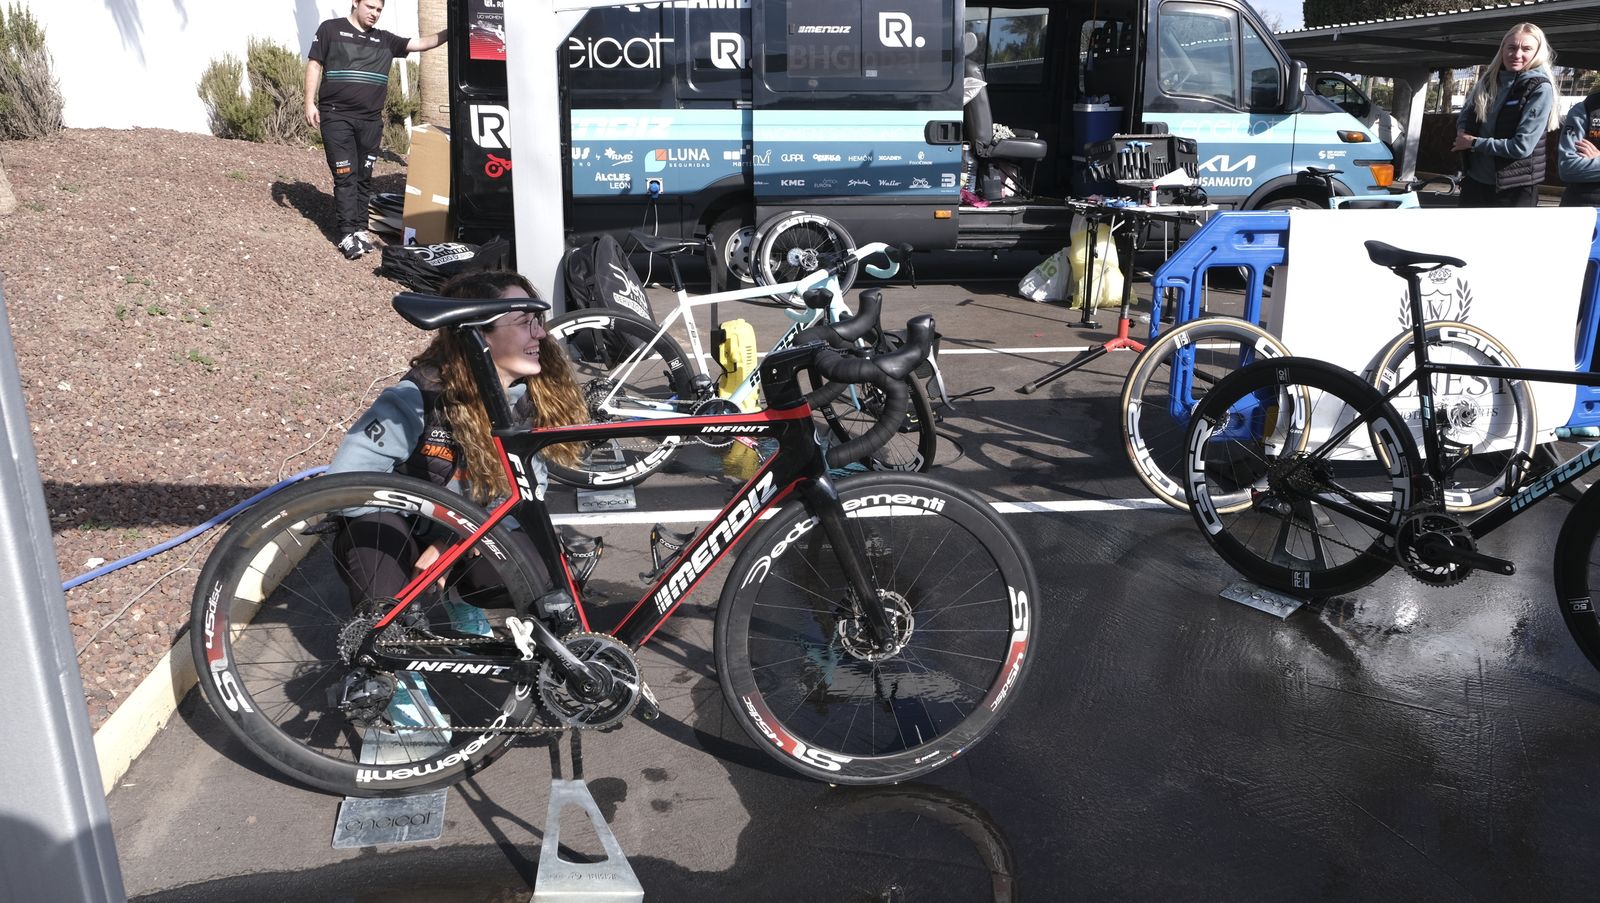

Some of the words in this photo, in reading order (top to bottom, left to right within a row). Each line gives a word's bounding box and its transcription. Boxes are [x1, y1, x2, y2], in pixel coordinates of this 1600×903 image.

[797, 25, 851, 34] MENDIZ
[668, 149, 710, 161] LUNA
[595, 172, 631, 182] ALCLES
[610, 181, 631, 190] LEÓN
[781, 179, 805, 187] KMC
[701, 425, 769, 433] INFINIT
[506, 451, 534, 502] F12
[654, 471, 777, 614] MENDIZ
[405, 660, 510, 675] INFINIT
